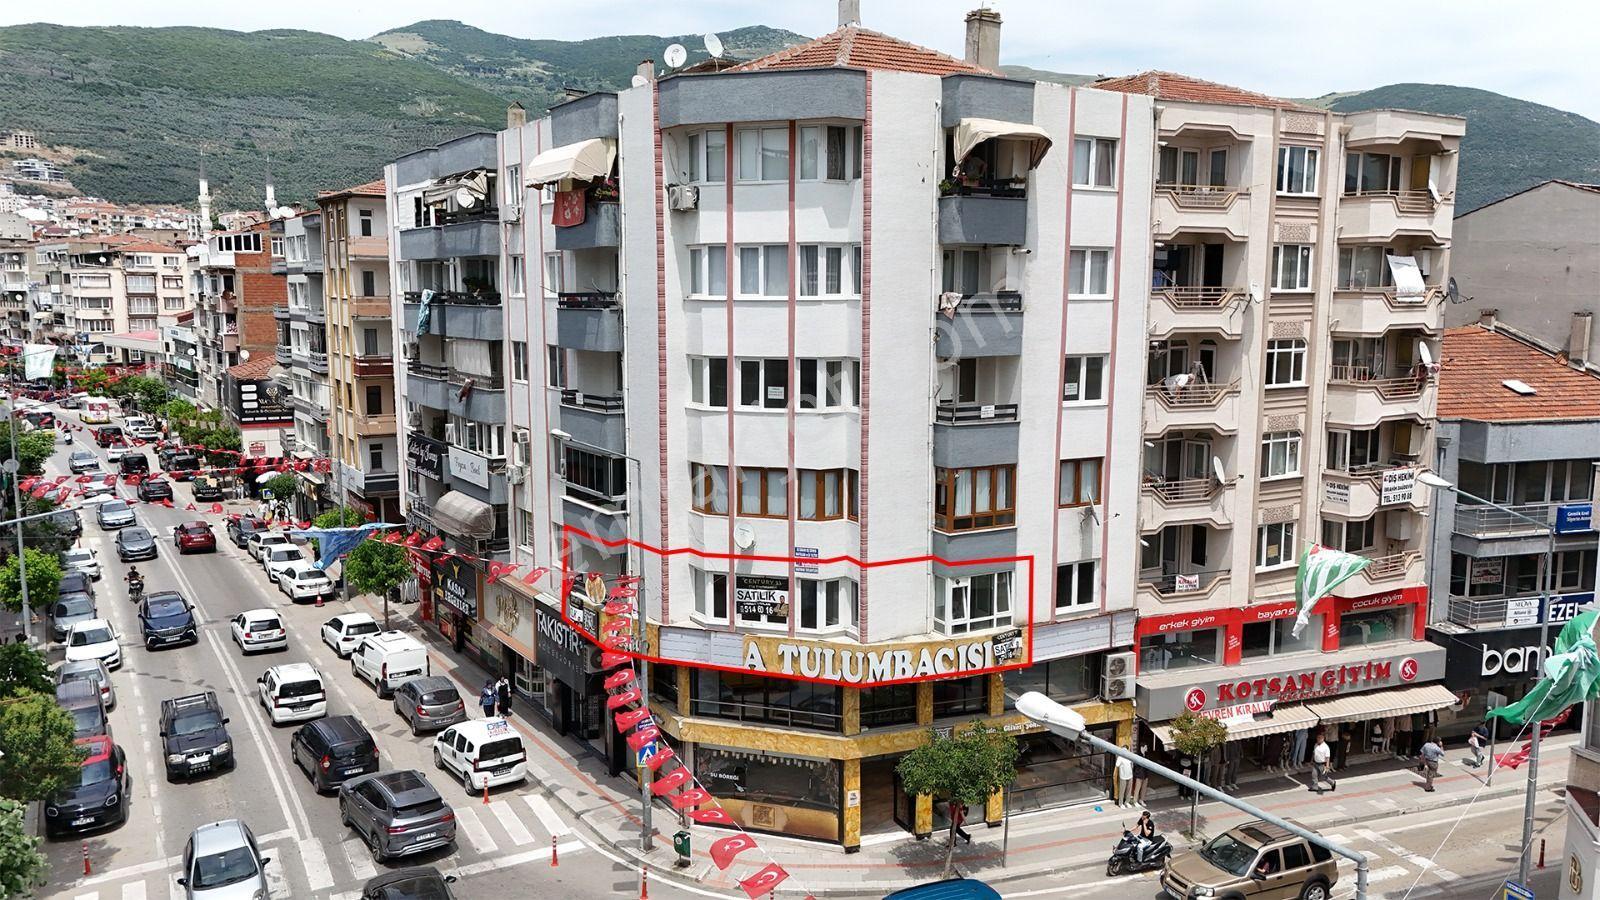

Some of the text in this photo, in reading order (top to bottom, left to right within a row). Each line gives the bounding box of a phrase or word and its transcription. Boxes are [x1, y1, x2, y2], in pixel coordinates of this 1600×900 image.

[737, 590, 776, 602] SATILIK
[1352, 592, 1403, 610] çocuk giyim
[1159, 614, 1216, 631] erkek giyim
[1257, 610, 1286, 620] bayan
[745, 640, 994, 685] A TULUMBACISI
[1217, 661, 1392, 702] KOTSAN GİYİM
